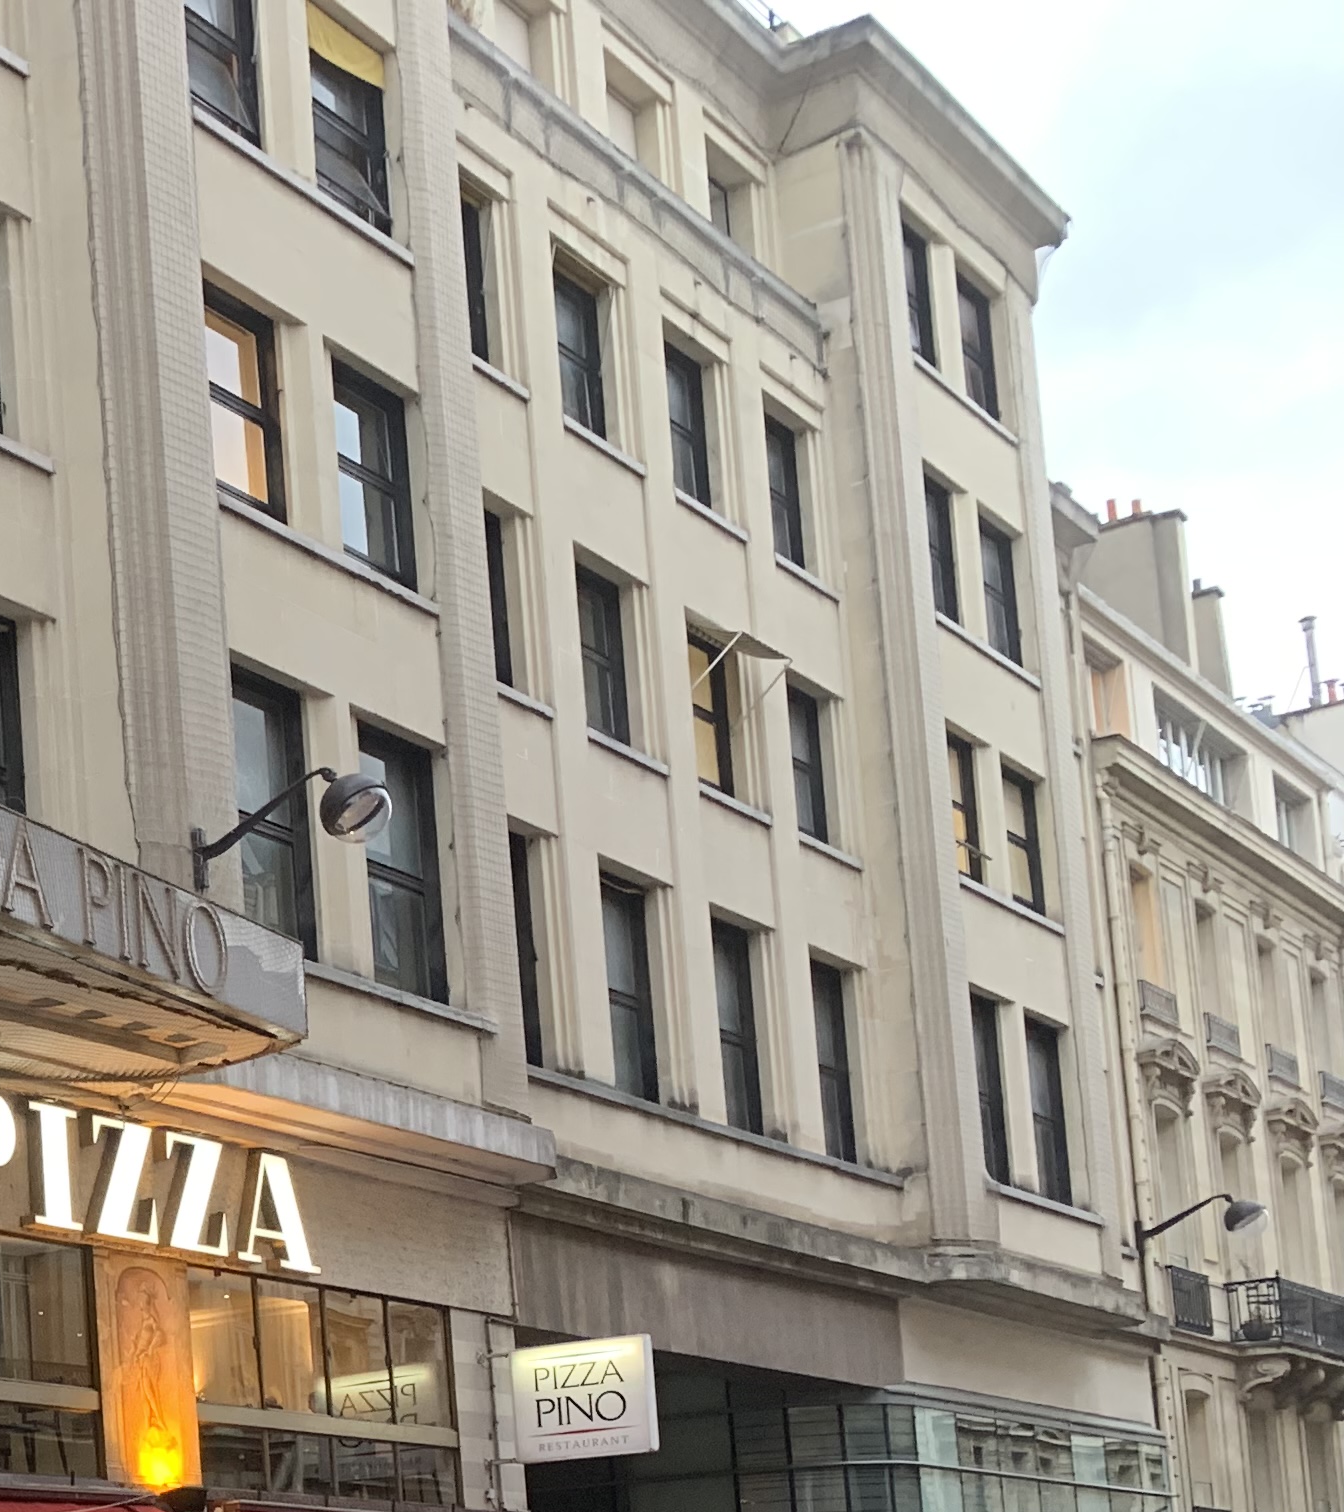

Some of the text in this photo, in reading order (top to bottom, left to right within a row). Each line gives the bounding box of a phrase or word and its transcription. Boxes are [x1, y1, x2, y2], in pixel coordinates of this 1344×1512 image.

[78, 845, 230, 995] PINO
[532, 1359, 625, 1393] PIZZA
[535, 1389, 628, 1428] PINO
[538, 1434, 630, 1453] RESTAURANT
